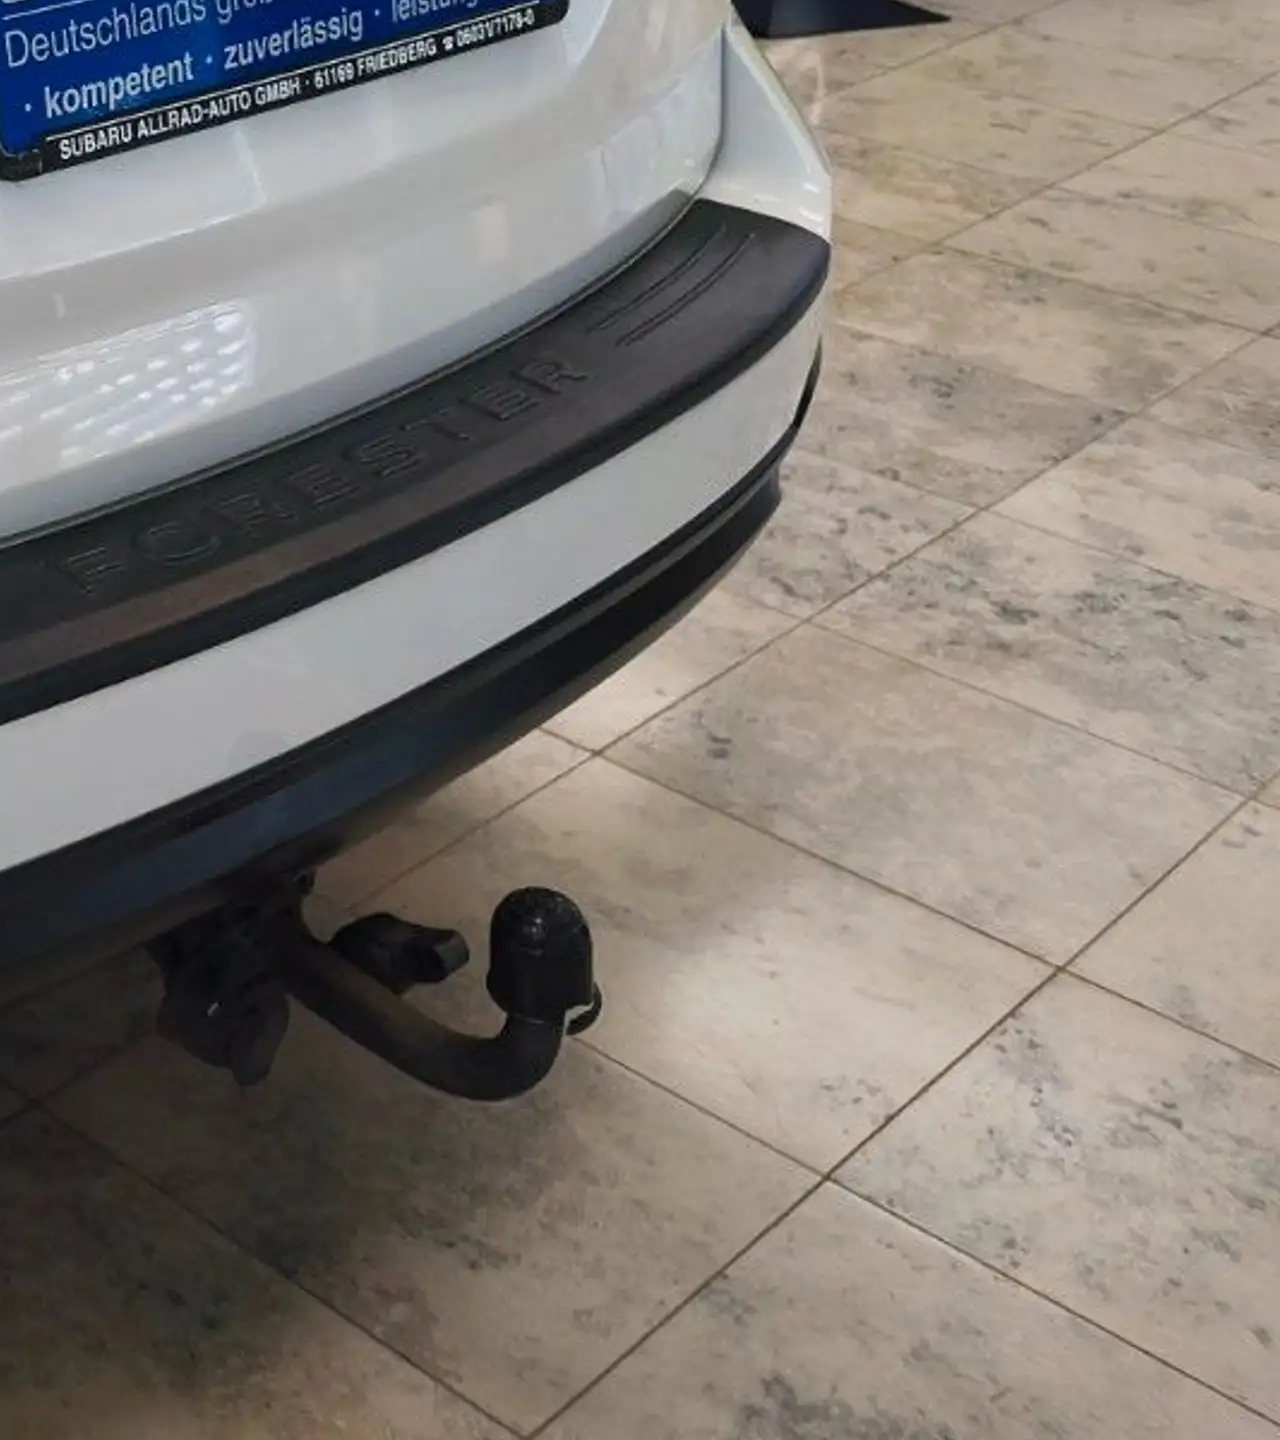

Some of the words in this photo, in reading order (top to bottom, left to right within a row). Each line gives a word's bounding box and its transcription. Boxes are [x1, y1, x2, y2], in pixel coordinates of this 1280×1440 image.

[43, 50, 194, 119] kompetent
[223, 6, 364, 71] zuverlässig
[58, 124, 133, 160] SUBARU
[137, 90, 253, 139] ALLRAD-AUTO
[254, 76, 301, 106] GMBH
[357, 37, 437, 77] FRIEDBERG
[55, 359, 594, 595] FORESTER
